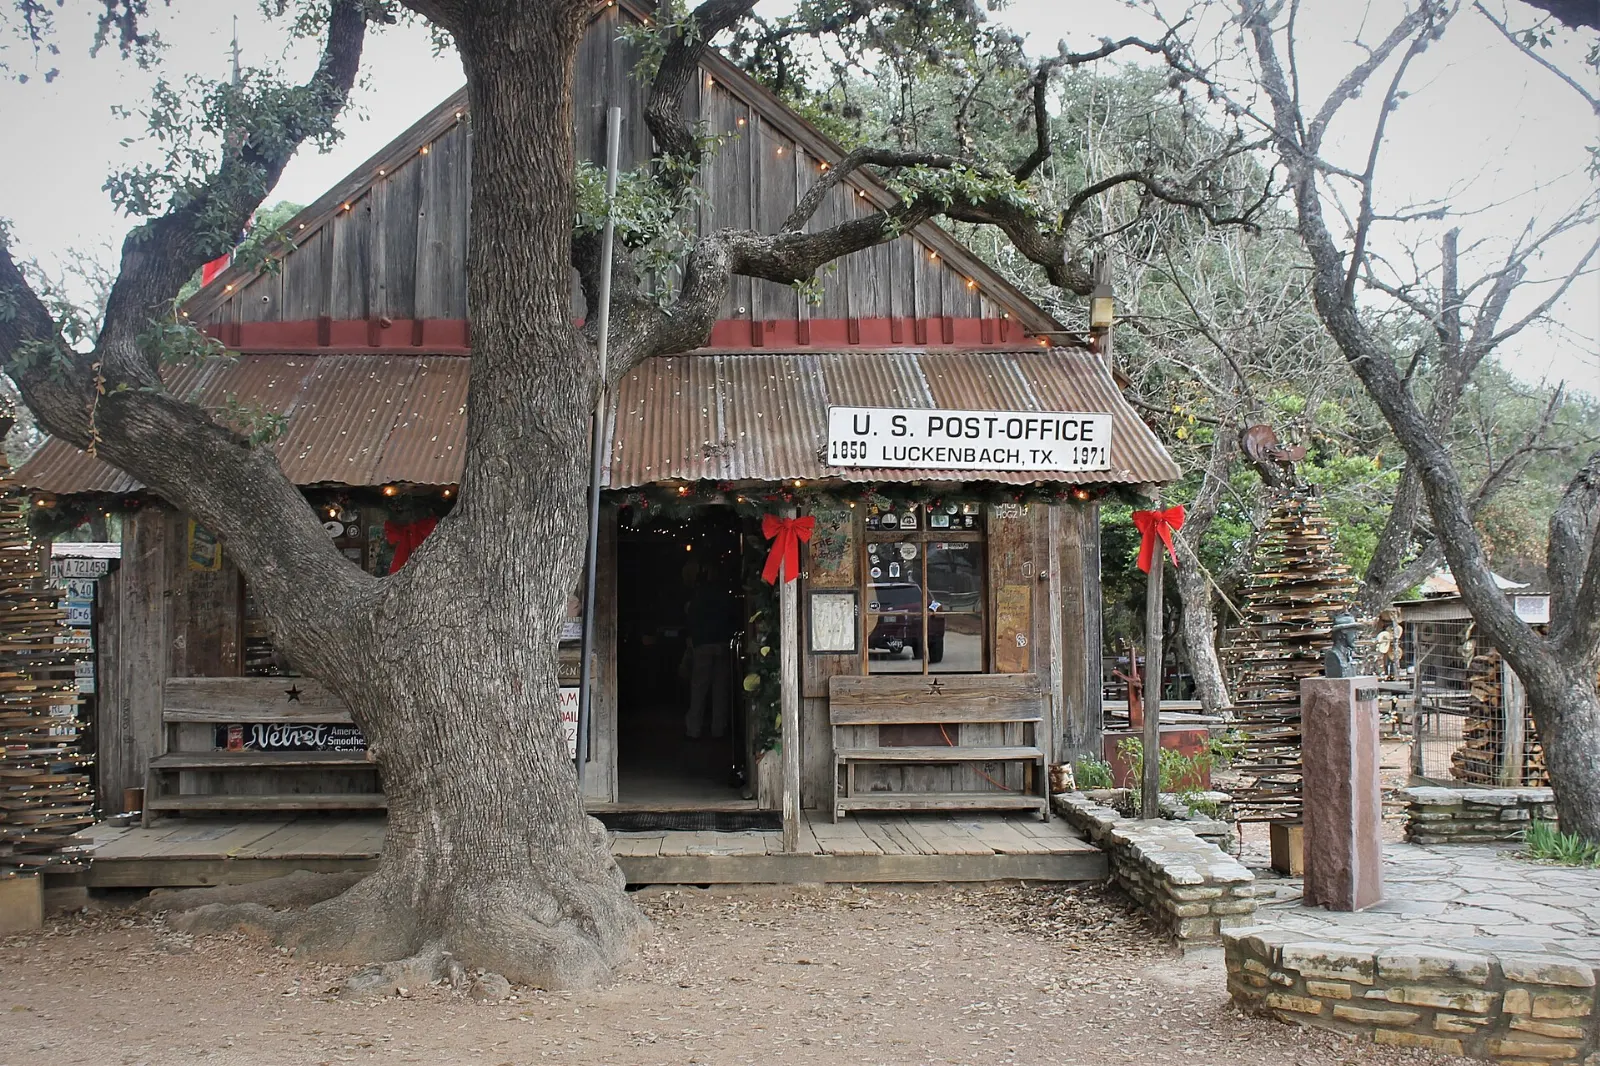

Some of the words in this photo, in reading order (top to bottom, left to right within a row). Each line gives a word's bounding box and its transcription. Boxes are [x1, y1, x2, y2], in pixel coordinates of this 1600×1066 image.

[853, 414, 877, 436] U.
[891, 414, 914, 438] S.
[928, 416, 1094, 442] POST-OFFICE
[832, 440, 867, 460] 1850
[882, 445, 1025, 466] LUCKENBACH,
[1029, 449, 1058, 465] TX.
[1072, 446, 1105, 466] 1971
[74, 560, 107, 573] 721459
[244, 723, 328, 748] Velvet
